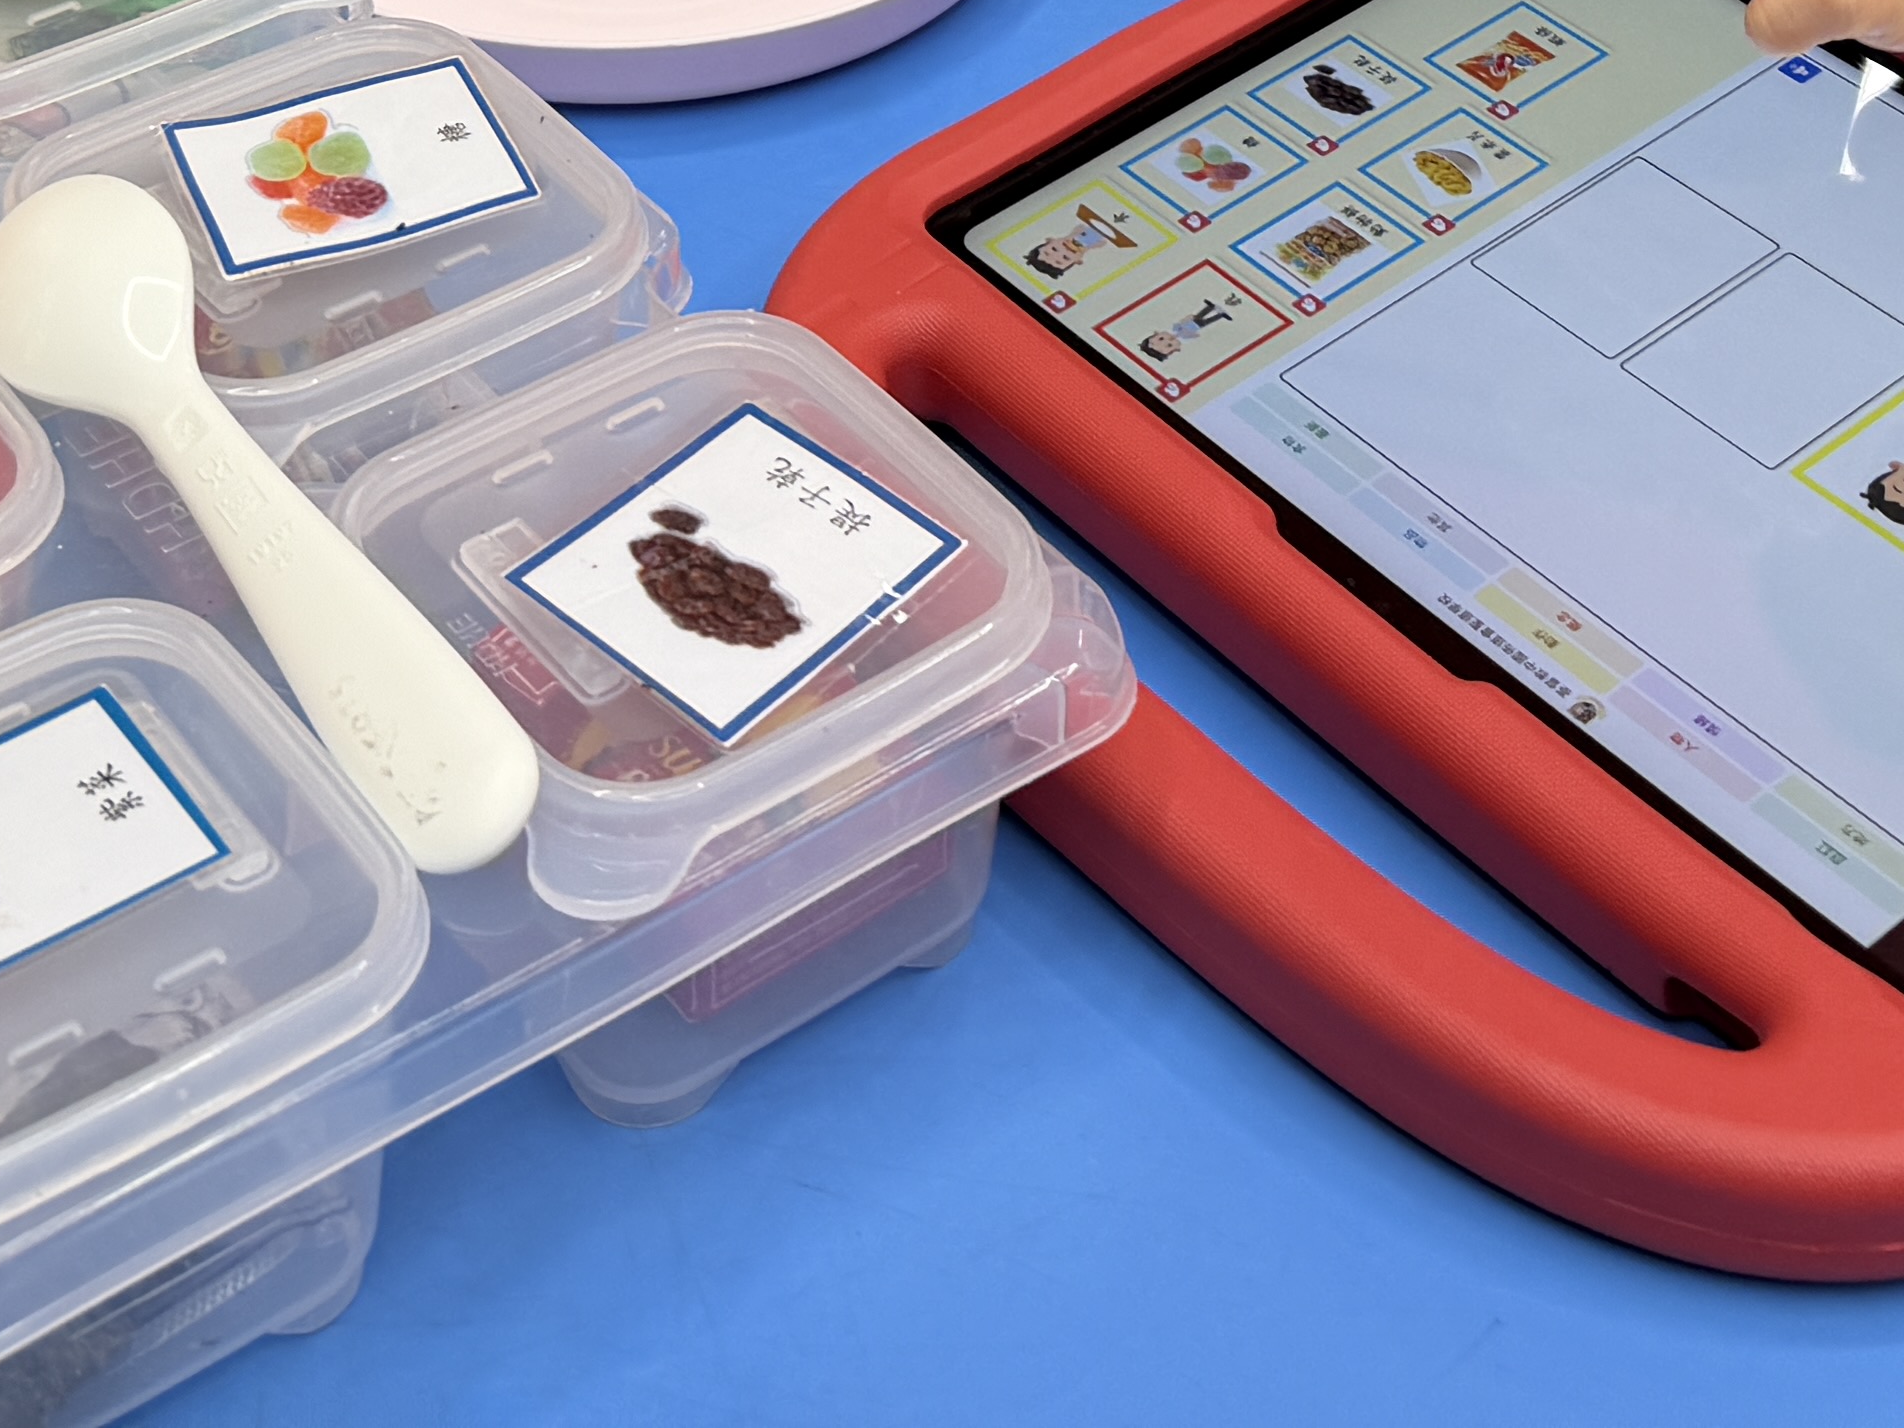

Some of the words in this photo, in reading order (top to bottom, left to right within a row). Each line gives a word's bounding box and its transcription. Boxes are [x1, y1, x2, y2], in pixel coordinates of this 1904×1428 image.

[436, 122, 471, 144] 糖
[765, 455, 872, 538] 提子乾
[77, 762, 145, 821] 紫菜
